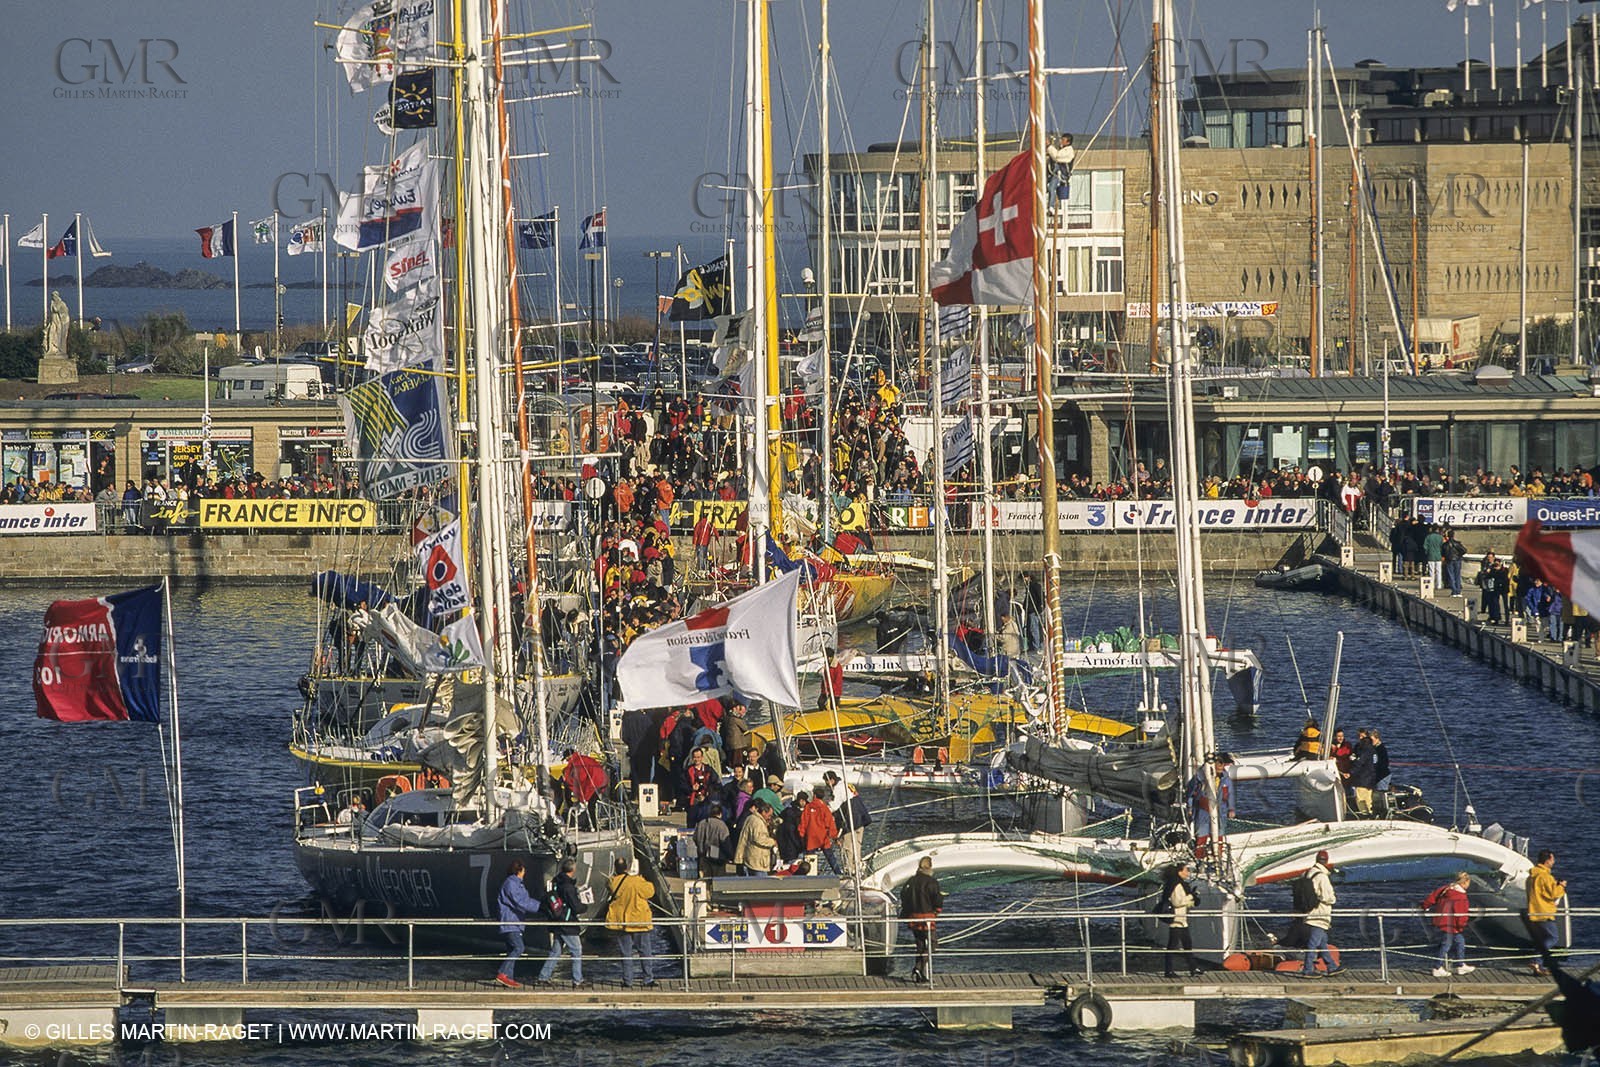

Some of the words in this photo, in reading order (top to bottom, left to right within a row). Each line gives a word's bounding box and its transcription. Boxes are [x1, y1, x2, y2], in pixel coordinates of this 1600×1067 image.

[173, 445, 202, 454] JERSEY
[43, 507, 88, 528] inter
[204, 504, 298, 523] FRANCE
[309, 504, 367, 523] INFO
[1087, 510, 1106, 526] 3
[1243, 500, 1309, 524] inter
[1438, 514, 1456, 523] de
[1463, 514, 1514, 524] France
[470, 854, 492, 918] 7
[770, 924, 782, 941] 1
